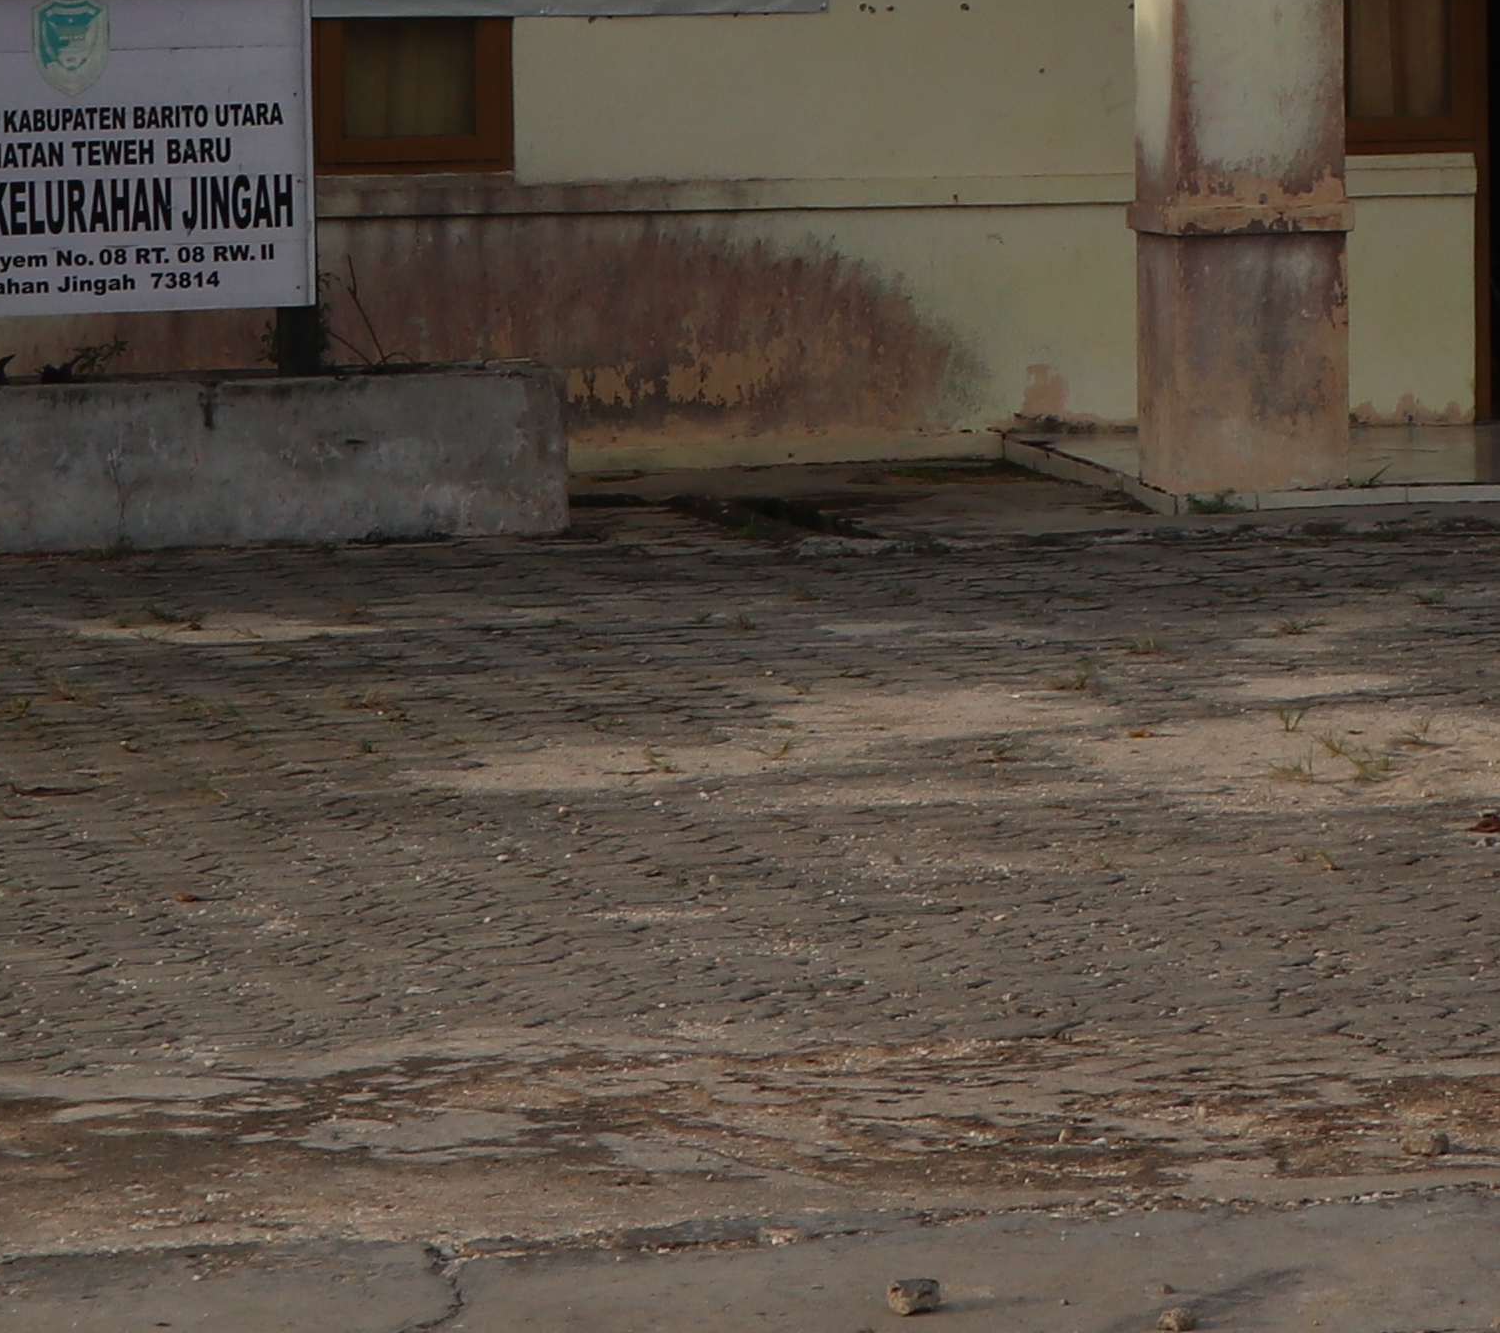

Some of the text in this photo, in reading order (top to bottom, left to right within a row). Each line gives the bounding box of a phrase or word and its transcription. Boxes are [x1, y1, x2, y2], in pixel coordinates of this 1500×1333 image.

[4, 107, 126, 133] KABUPATEN
[133, 104, 208, 130] BARITO
[215, 102, 284, 127] UTARA
[72, 139, 154, 166] TEWEH
[167, 137, 231, 165] BARU
[182, 174, 294, 232] JINGAH
[56, 249, 94, 267] No.
[99, 248, 127, 266] 08
[135, 247, 170, 264] RT.
[178, 246, 205, 263] 08
[213, 244, 256, 262] RW.
[57, 275, 135, 295] Jingah
[150, 271, 221, 289] 73814
